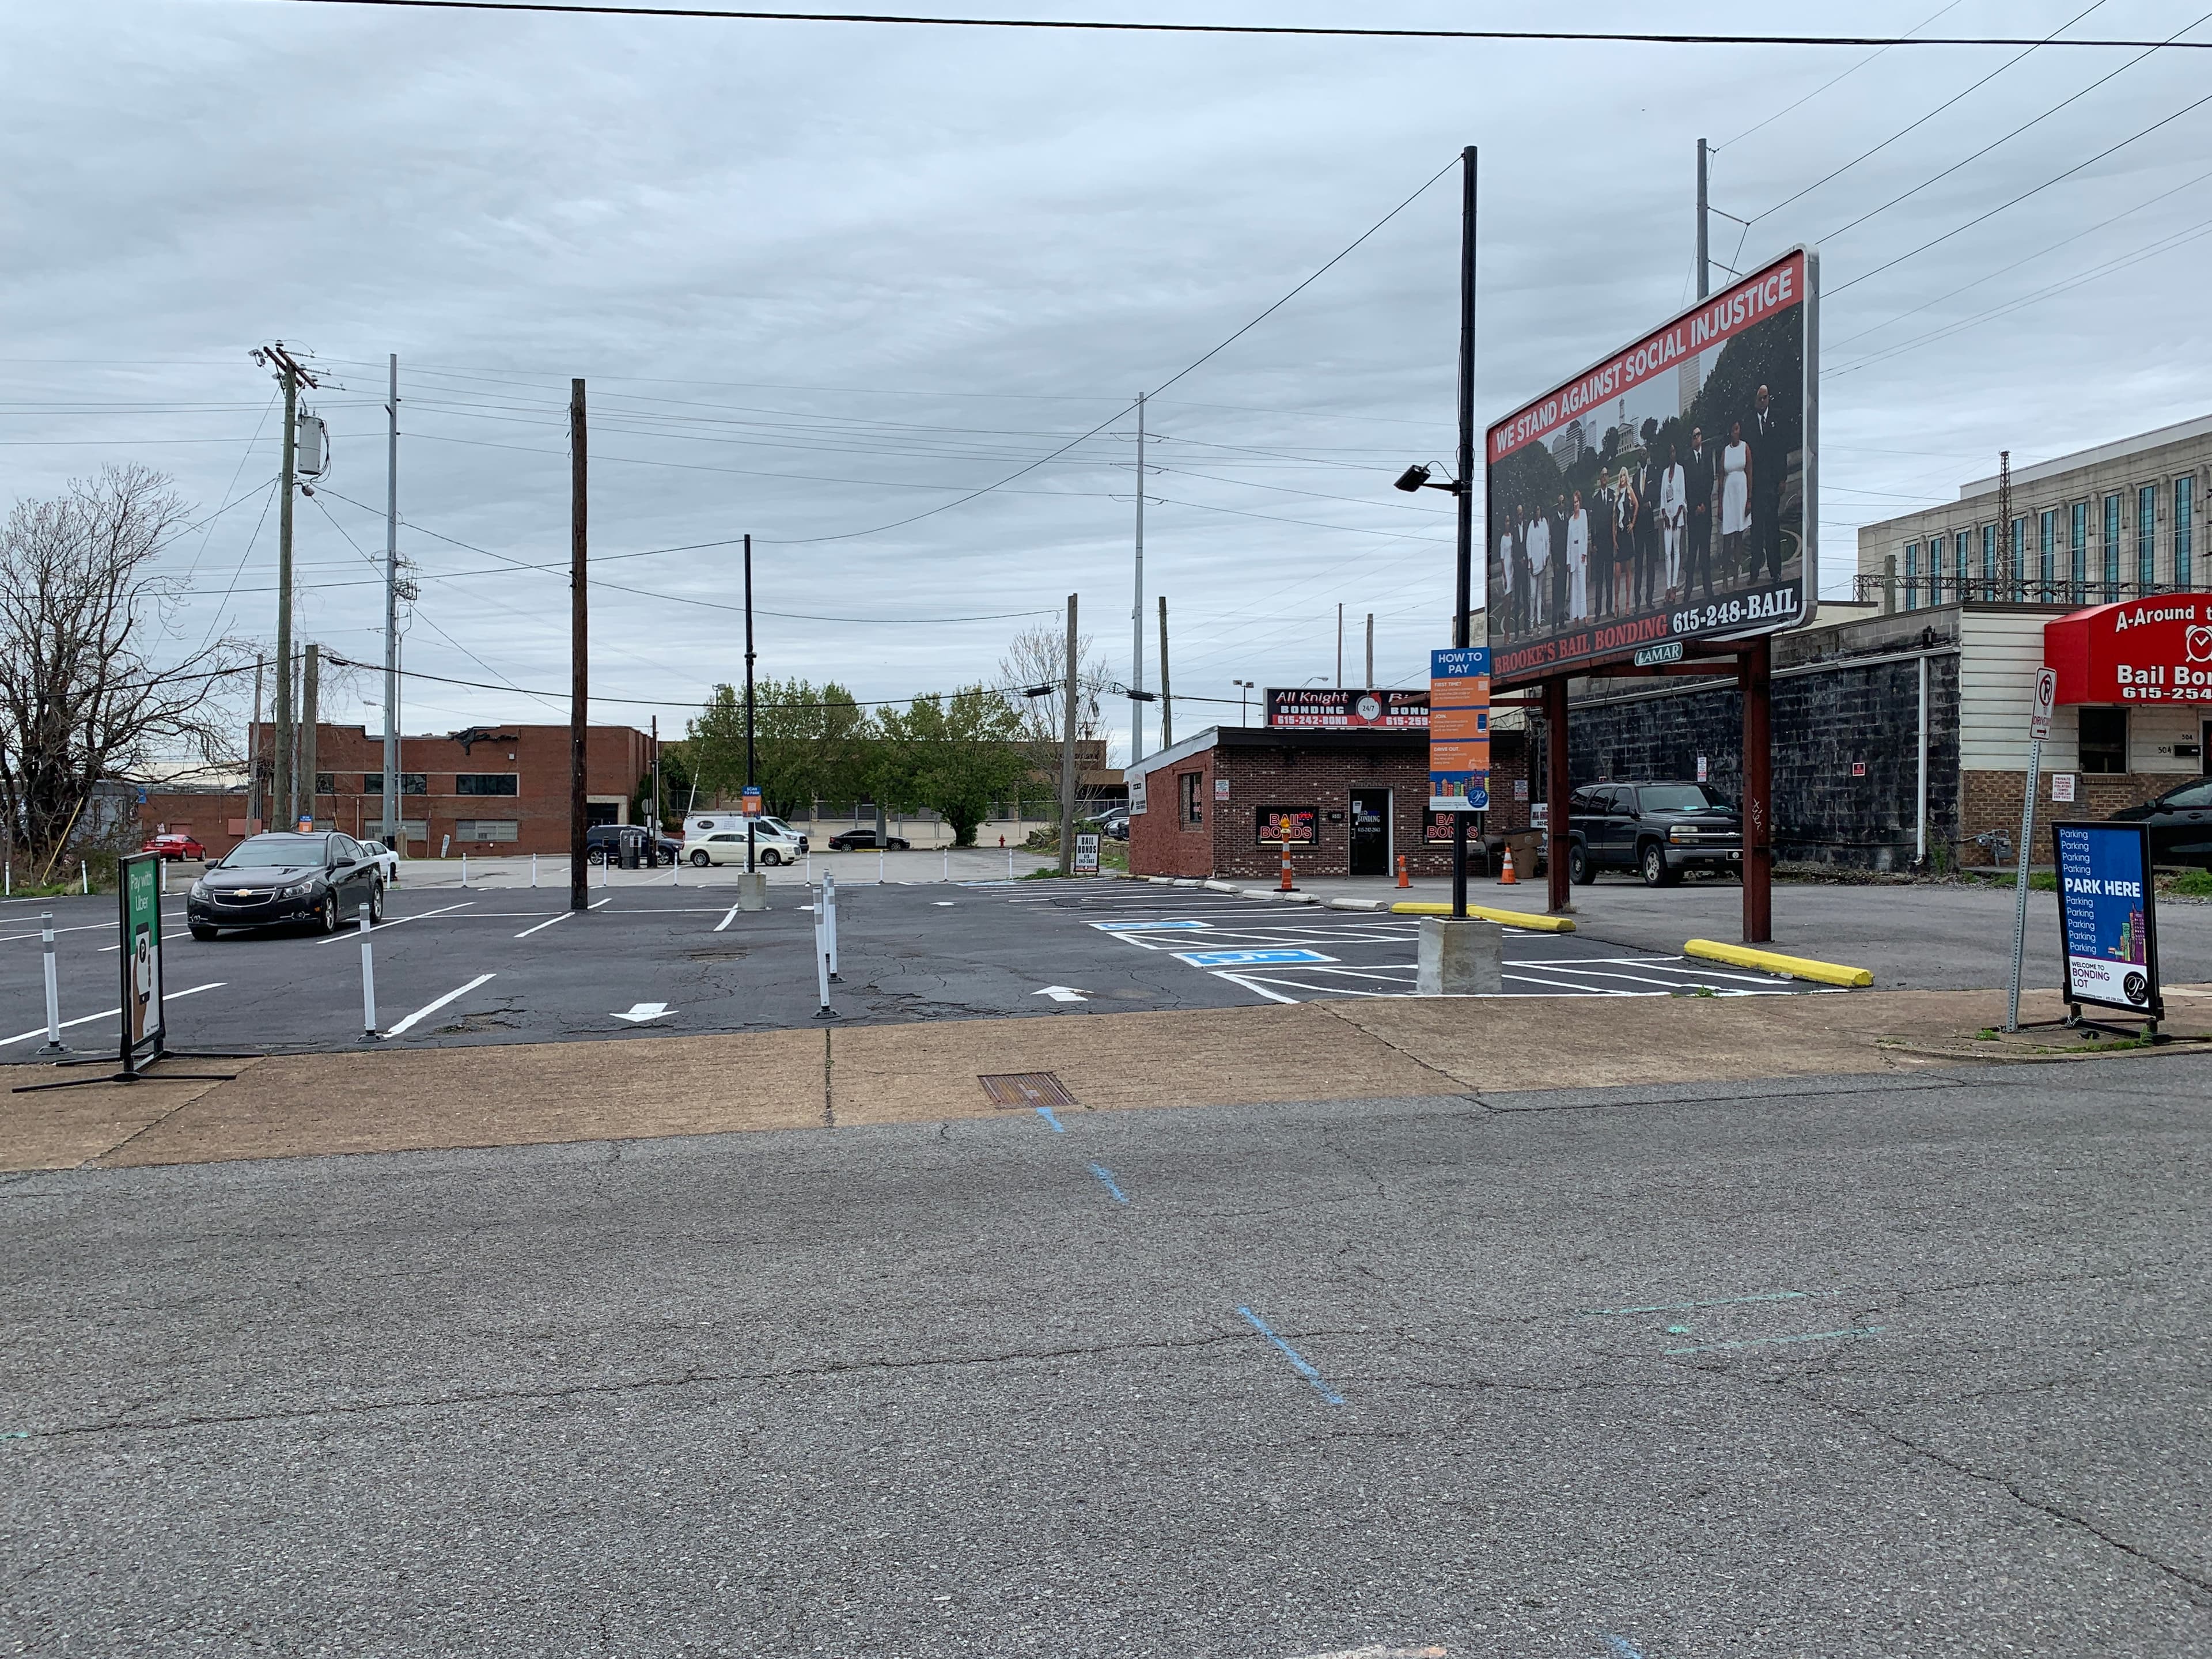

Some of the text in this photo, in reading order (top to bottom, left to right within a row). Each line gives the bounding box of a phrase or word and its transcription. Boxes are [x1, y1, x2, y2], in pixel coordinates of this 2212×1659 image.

[1496, 267, 1793, 453] WE STAND AGAINST SOCIAL INJUSTICE
[2115, 605, 2195, 632] A-Around
[1494, 588, 1797, 675] BROOKE'S BAIL BONDING 615-248-BAIL
[1438, 652, 1482, 664] HOW TO
[1638, 645, 1680, 664] LAMAR
[1448, 664, 1469, 674] PAY
[2118, 665, 2164, 684] Bail
[1275, 692, 1349, 705] All Knight
[1281, 706, 1344, 714] BONDING
[1277, 716, 1347, 725] 615-242-BOND
[1081, 837, 1093, 845] BAIL
[2061, 830, 2088, 840] Parking
[1078, 846, 1096, 854] BONDS
[2062, 841, 2089, 851] Parking
[2062, 853, 2090, 863] Parking
[2063, 864, 2091, 875] Parking
[131, 871, 152, 893] Pay with
[2065, 878, 2141, 897] PARK HERE
[135, 895, 149, 911] Uber
[2066, 896, 2093, 907] Parking
[2067, 907, 2094, 919] Parking
[2068, 919, 2094, 931] Parking
[2069, 930, 2096, 943] Parking
[2070, 942, 2097, 955] Parking
[2071, 961, 2096, 969] WELCOME
[2073, 968, 2110, 981] BONDING
[2073, 978, 2088, 988] LOT
